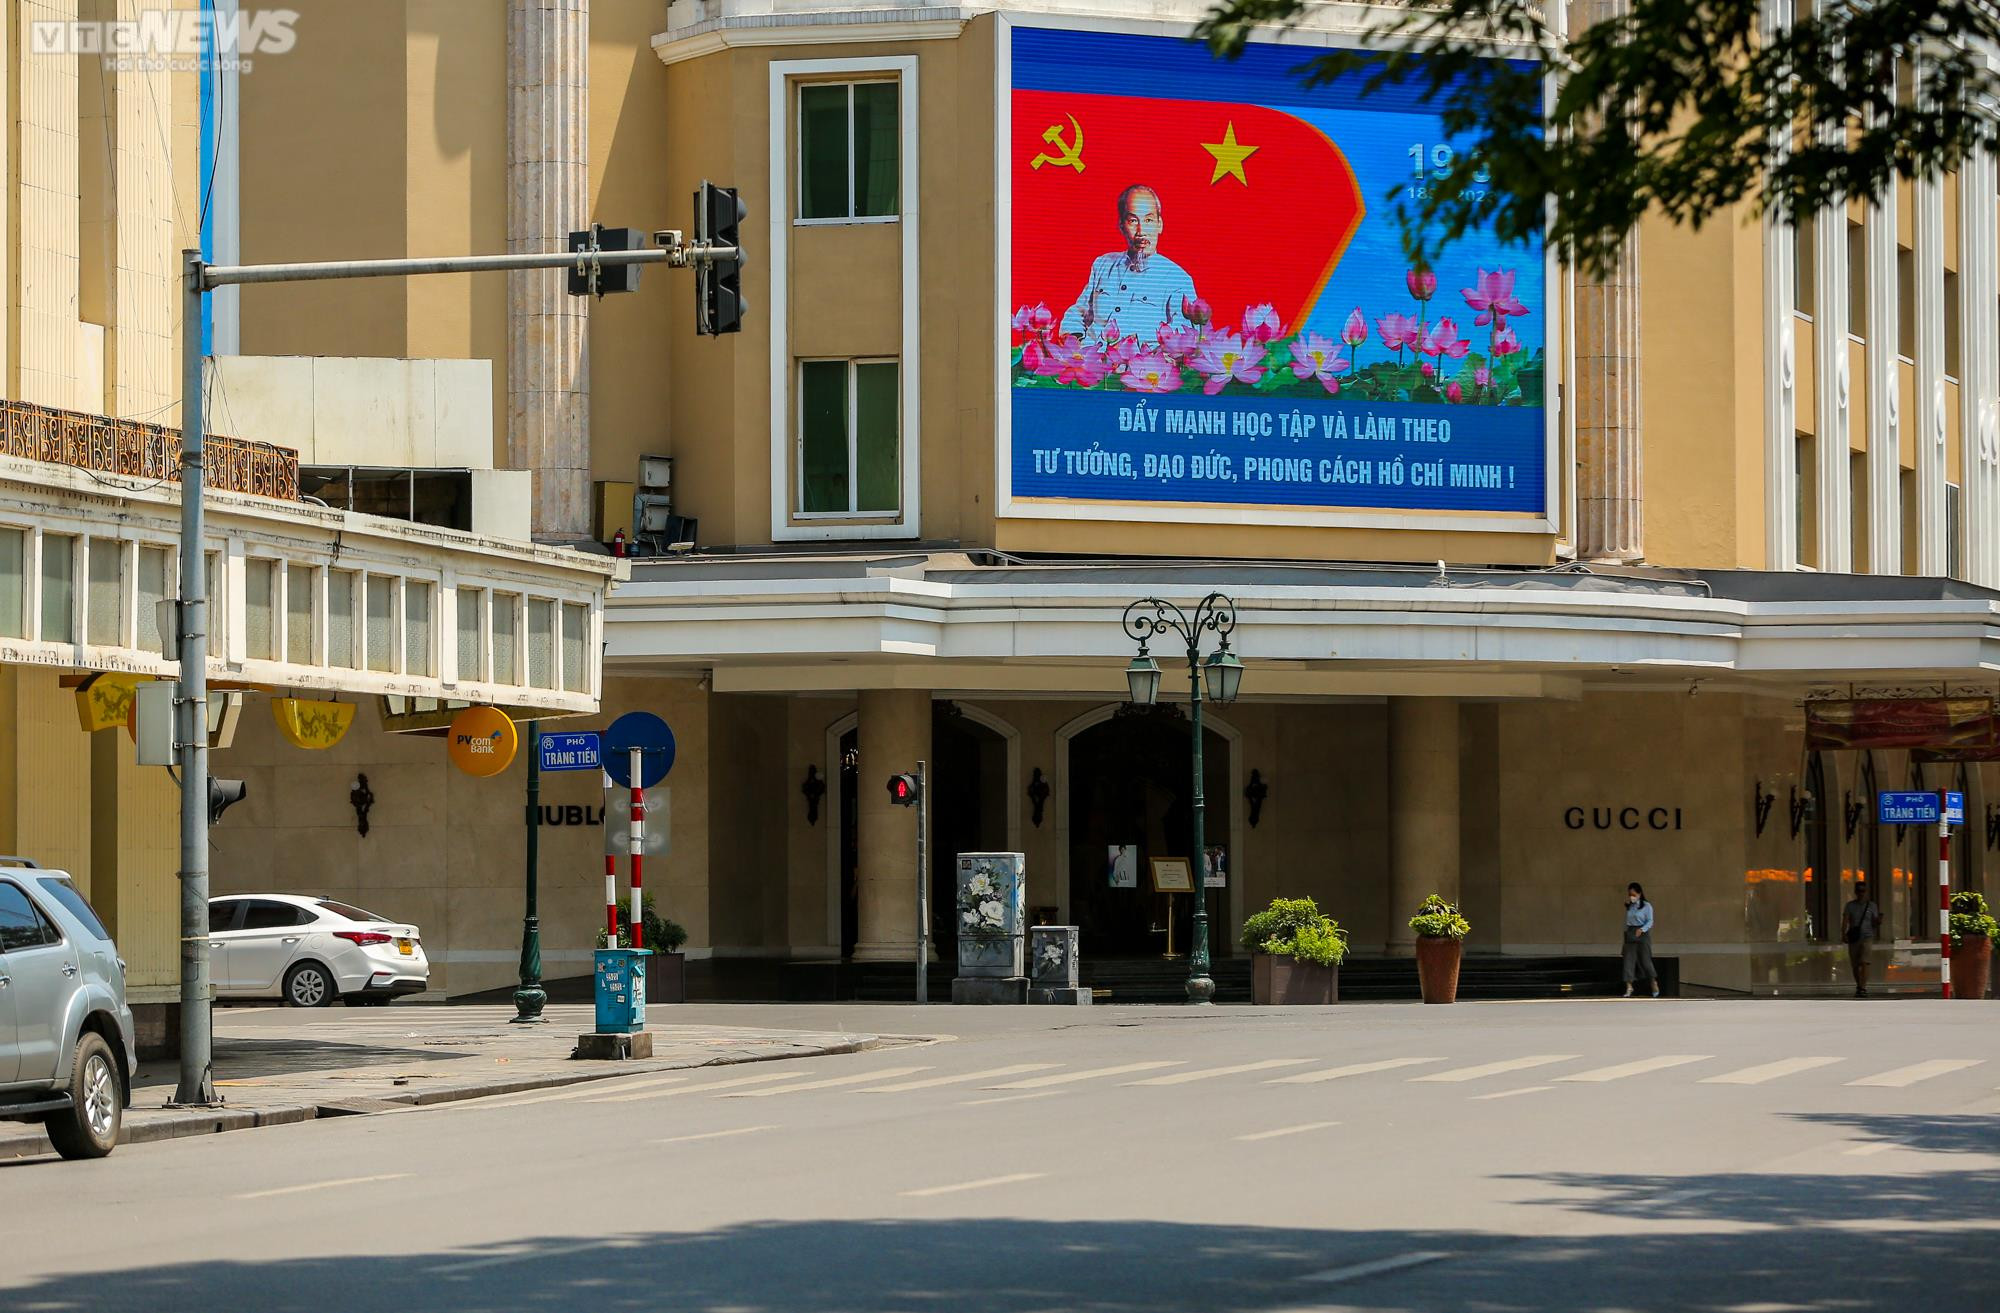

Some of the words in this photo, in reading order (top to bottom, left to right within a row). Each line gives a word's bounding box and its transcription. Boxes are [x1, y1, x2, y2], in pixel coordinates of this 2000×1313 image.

[1118, 398, 1159, 432] ĐẨY
[1165, 409, 1226, 439] MẠNH
[1232, 411, 1273, 441] HỌC
[1279, 409, 1316, 443] TẬP
[1322, 410, 1348, 439] VÀ
[1354, 412, 1396, 441] LÀM
[1402, 418, 1451, 443] THEO
[1032, 448, 1061, 474] TƯ
[1064, 441, 1137, 480] TƯỞNG,
[1144, 454, 1185, 483] ĐẠO
[1191, 449, 1237, 483] ĐỨC,
[1244, 457, 1313, 483] PHONG
[1319, 455, 1372, 484] CÁCH
[1378, 454, 1405, 486] HỒ
[1411, 458, 1444, 487] CHÍ
[1450, 463, 1502, 489] MINH
[1508, 466, 1515, 489] !
[470, 744, 495, 754] Bank
[566, 735, 585, 746] PHỐ
[545, 749, 575, 765] TRÀNG
[526, 805, 605, 826] UBL
[1564, 806, 1682, 830] GUCCI
[1885, 805, 1914, 819] TRÀNG
